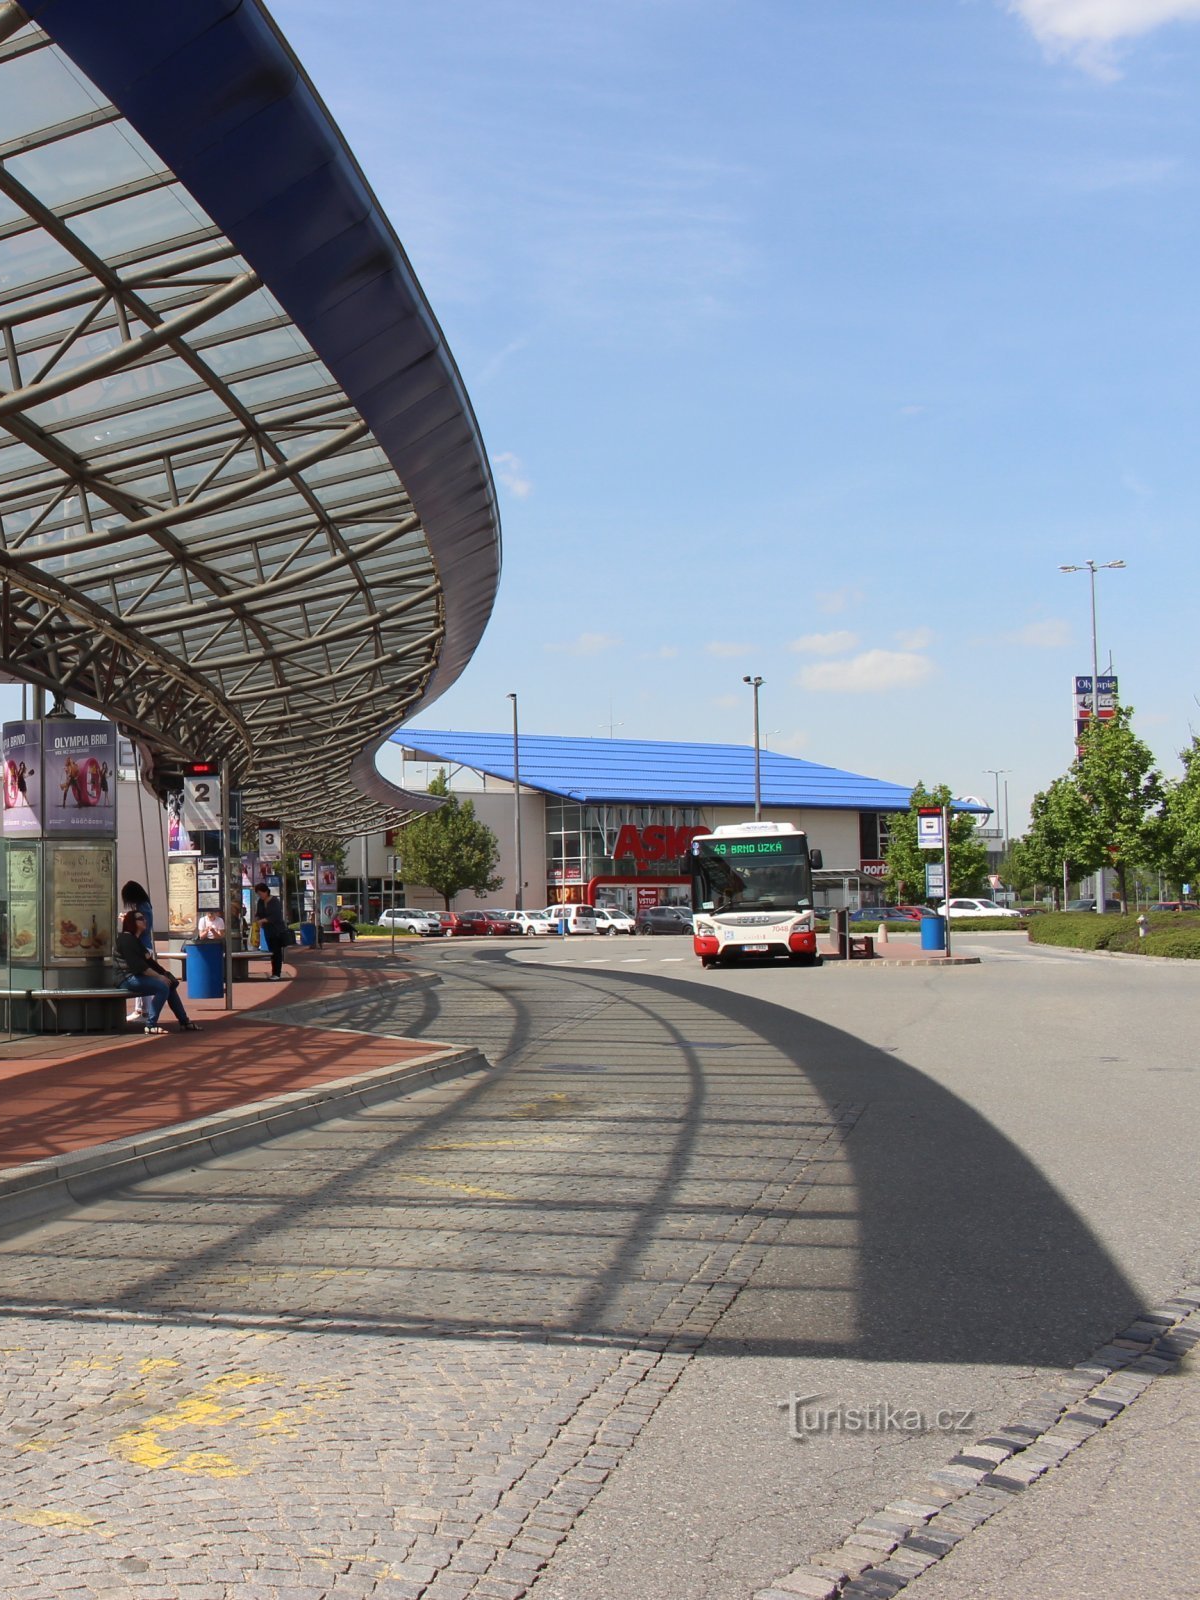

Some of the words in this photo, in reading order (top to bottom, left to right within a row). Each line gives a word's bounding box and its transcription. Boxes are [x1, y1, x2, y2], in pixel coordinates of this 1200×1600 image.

[54, 735, 89, 749] OLYMPIA
[90, 733, 108, 746] BRNO
[195, 783, 210, 802] 2
[265, 833, 274, 845] 3
[714, 843, 726, 855] 49
[731, 845, 755, 854] BRNO
